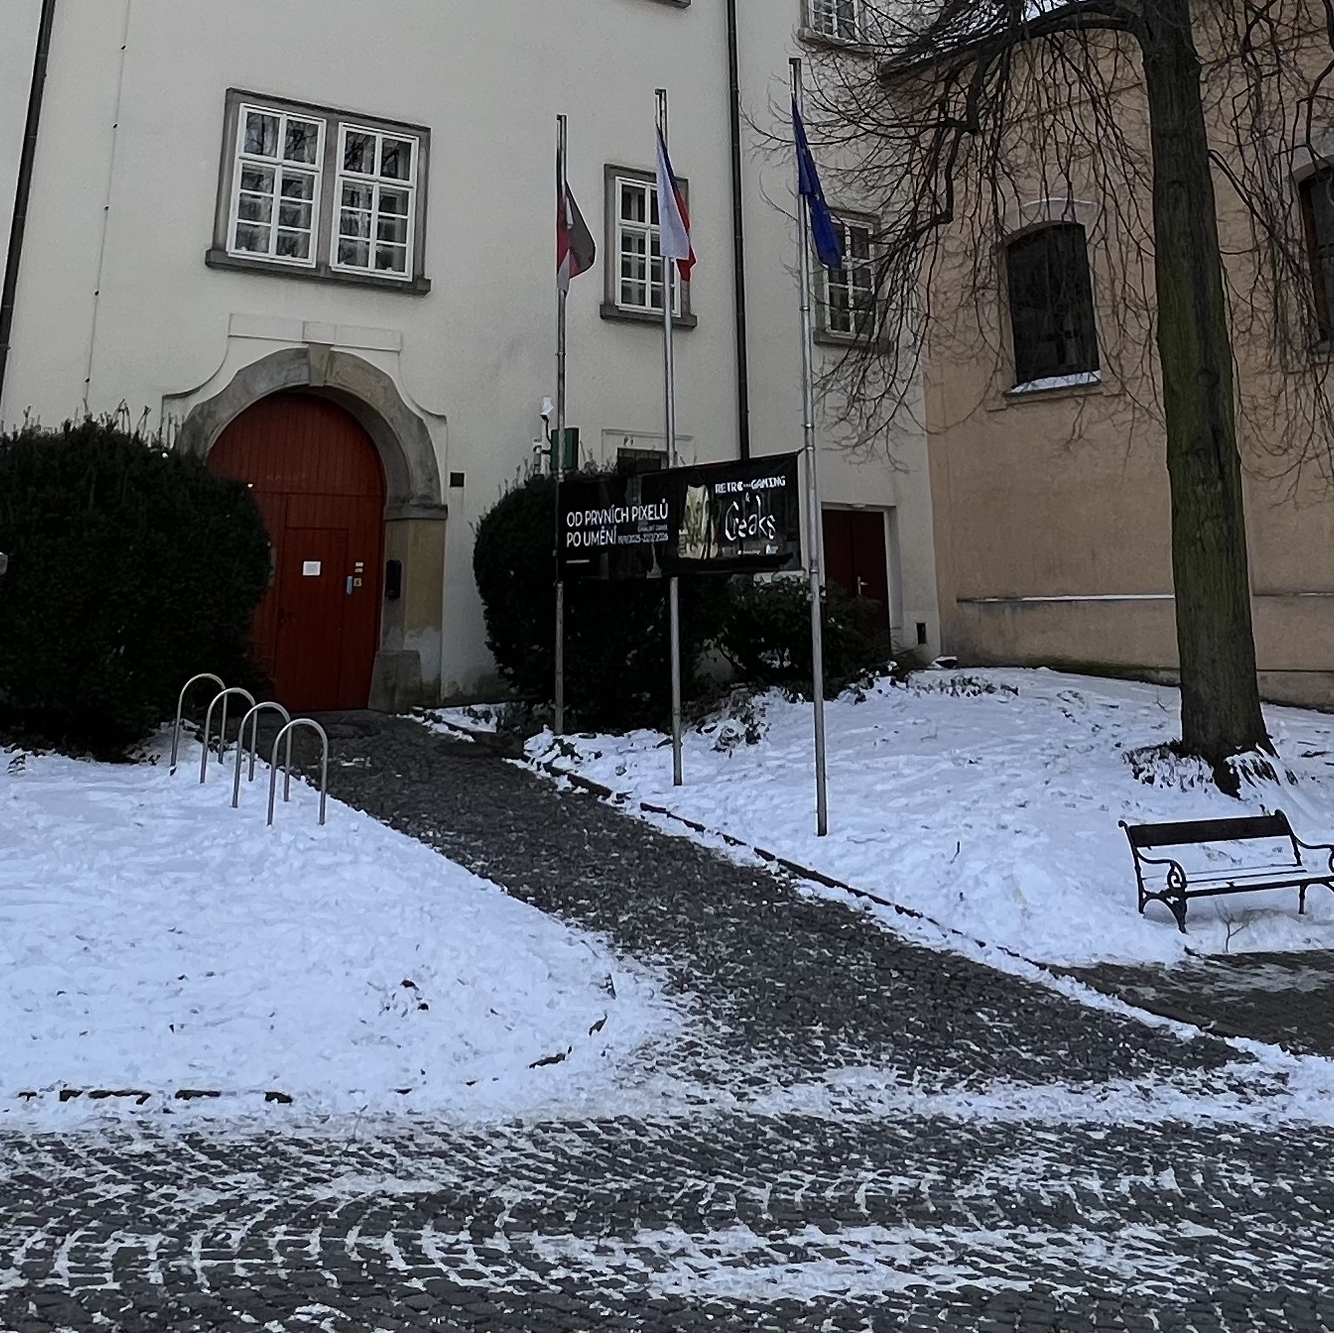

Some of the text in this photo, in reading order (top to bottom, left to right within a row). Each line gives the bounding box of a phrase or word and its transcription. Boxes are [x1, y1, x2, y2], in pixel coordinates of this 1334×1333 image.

[566, 497, 669, 527] OD PRVNÍCH PIXELŮ
[725, 494, 777, 541] Creaks
[566, 530, 582, 548] PO
[583, 524, 617, 547] UMĚNÍ
